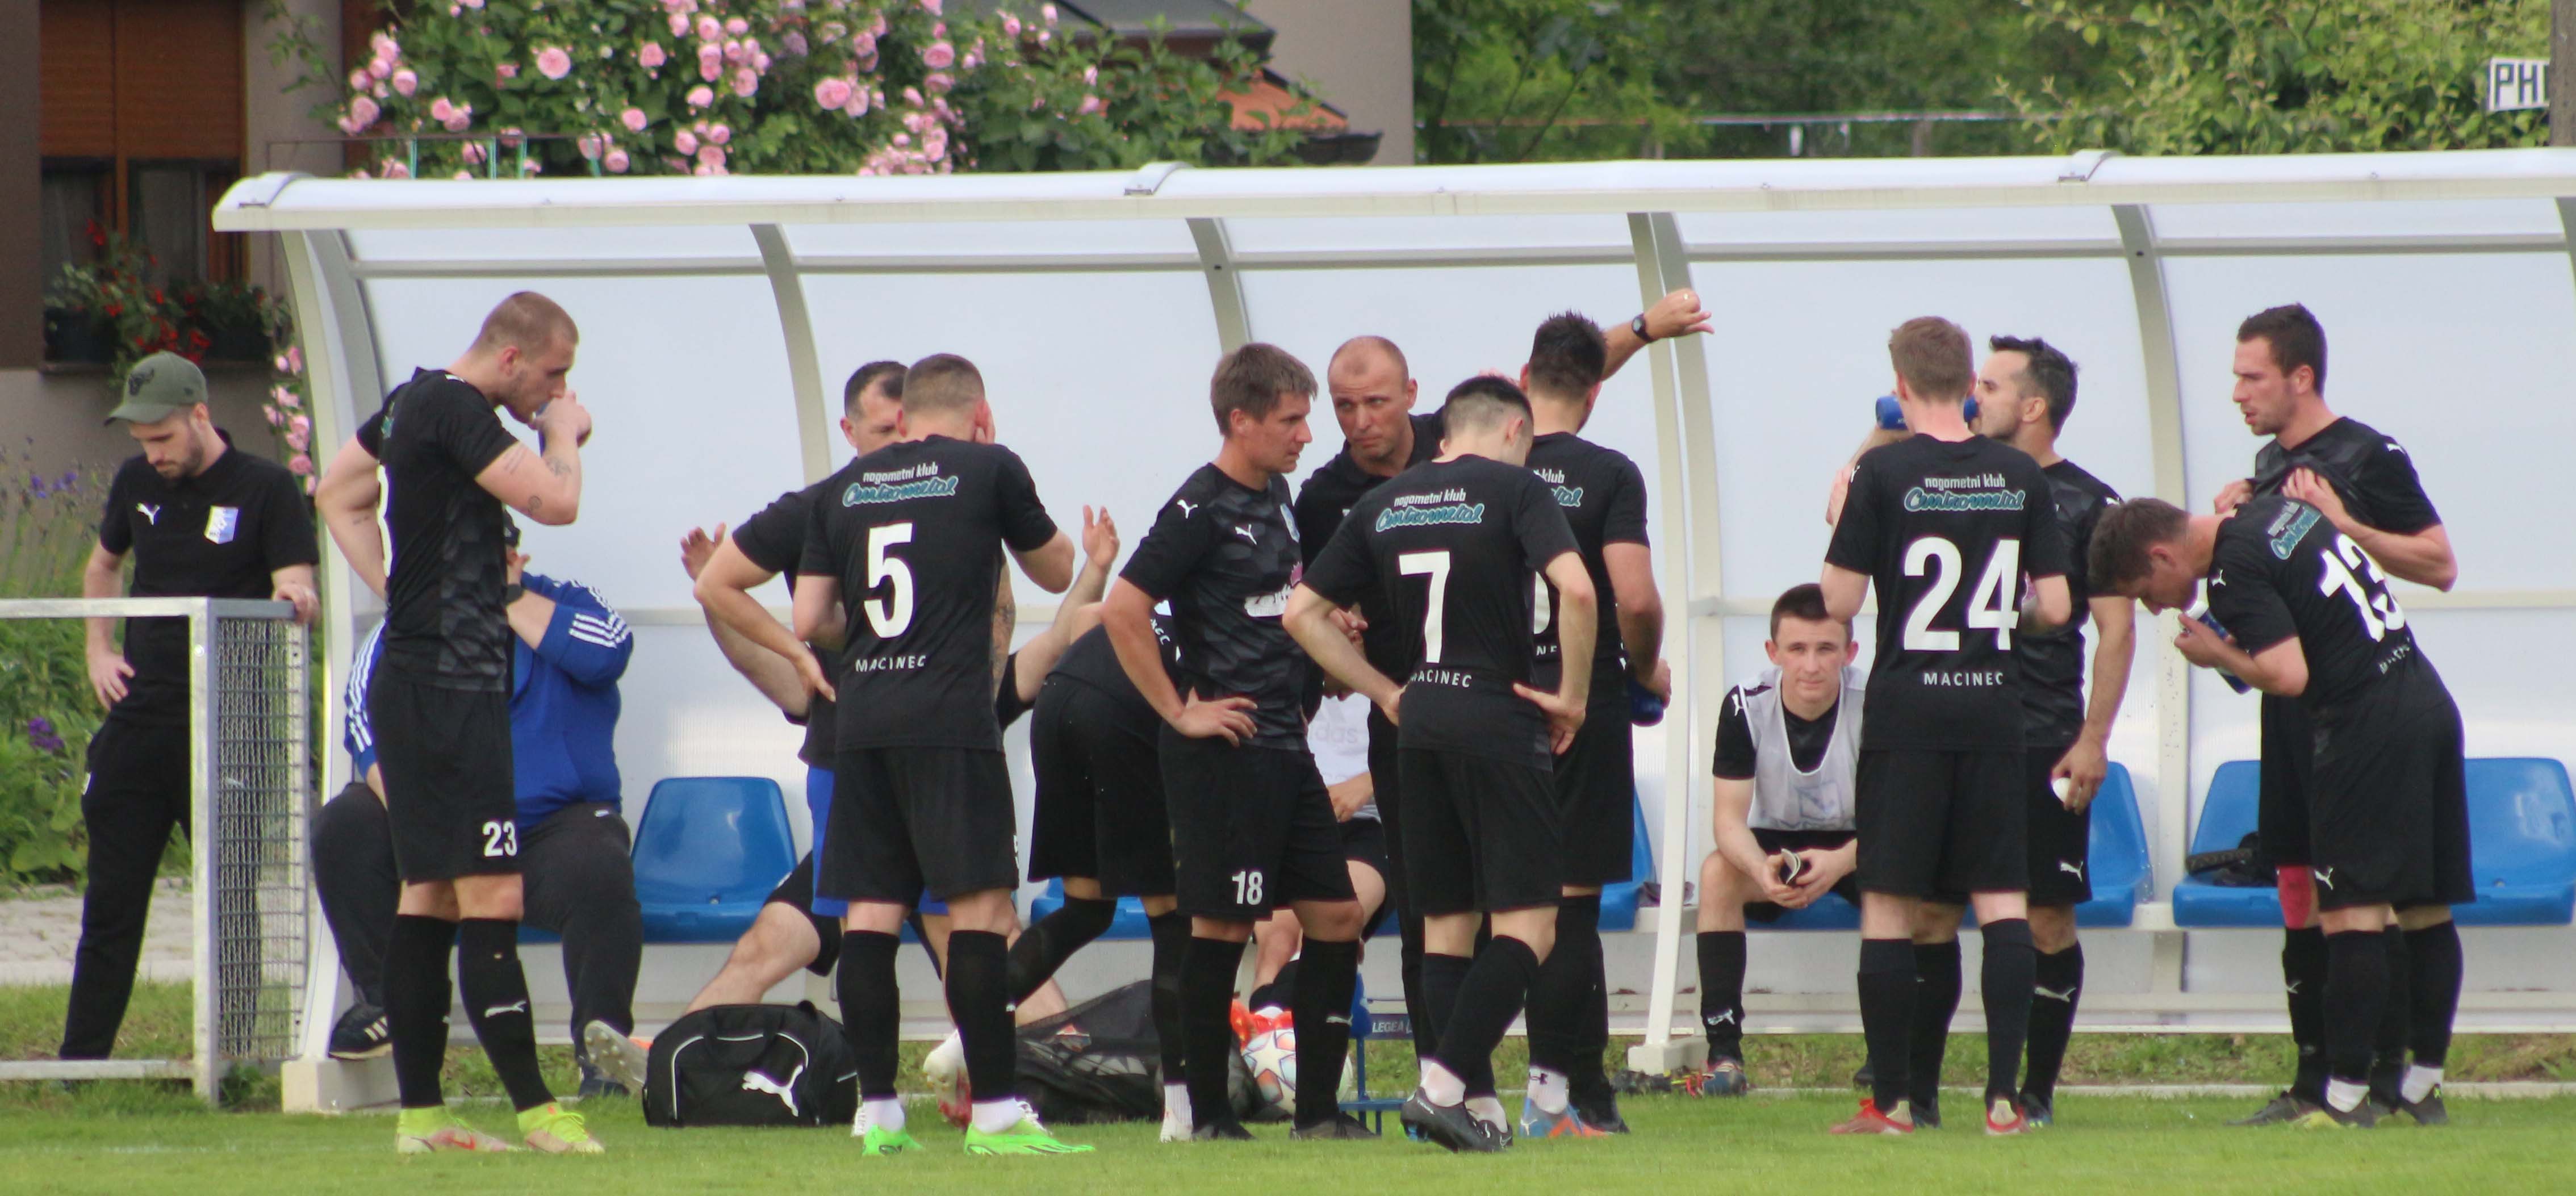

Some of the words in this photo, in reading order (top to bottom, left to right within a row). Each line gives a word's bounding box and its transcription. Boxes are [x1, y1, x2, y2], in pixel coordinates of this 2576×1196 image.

[863, 467, 915, 484] nogometni
[916, 461, 939, 478] klub
[1924, 475, 1981, 491] nogometni
[1983, 473, 2006, 488] klub
[1394, 492, 1442, 507] nogometni
[1444, 488, 1467, 502] klub
[863, 522, 914, 639] 5
[1904, 536, 2020, 651] 24
[2319, 533, 2406, 642] 13
[1399, 550, 1450, 664] 7
[855, 655, 926, 672] MACINEC
[1923, 672, 2004, 686] MACINEC
[482, 821, 517, 856] 23
[1232, 871, 1263, 905] 18
